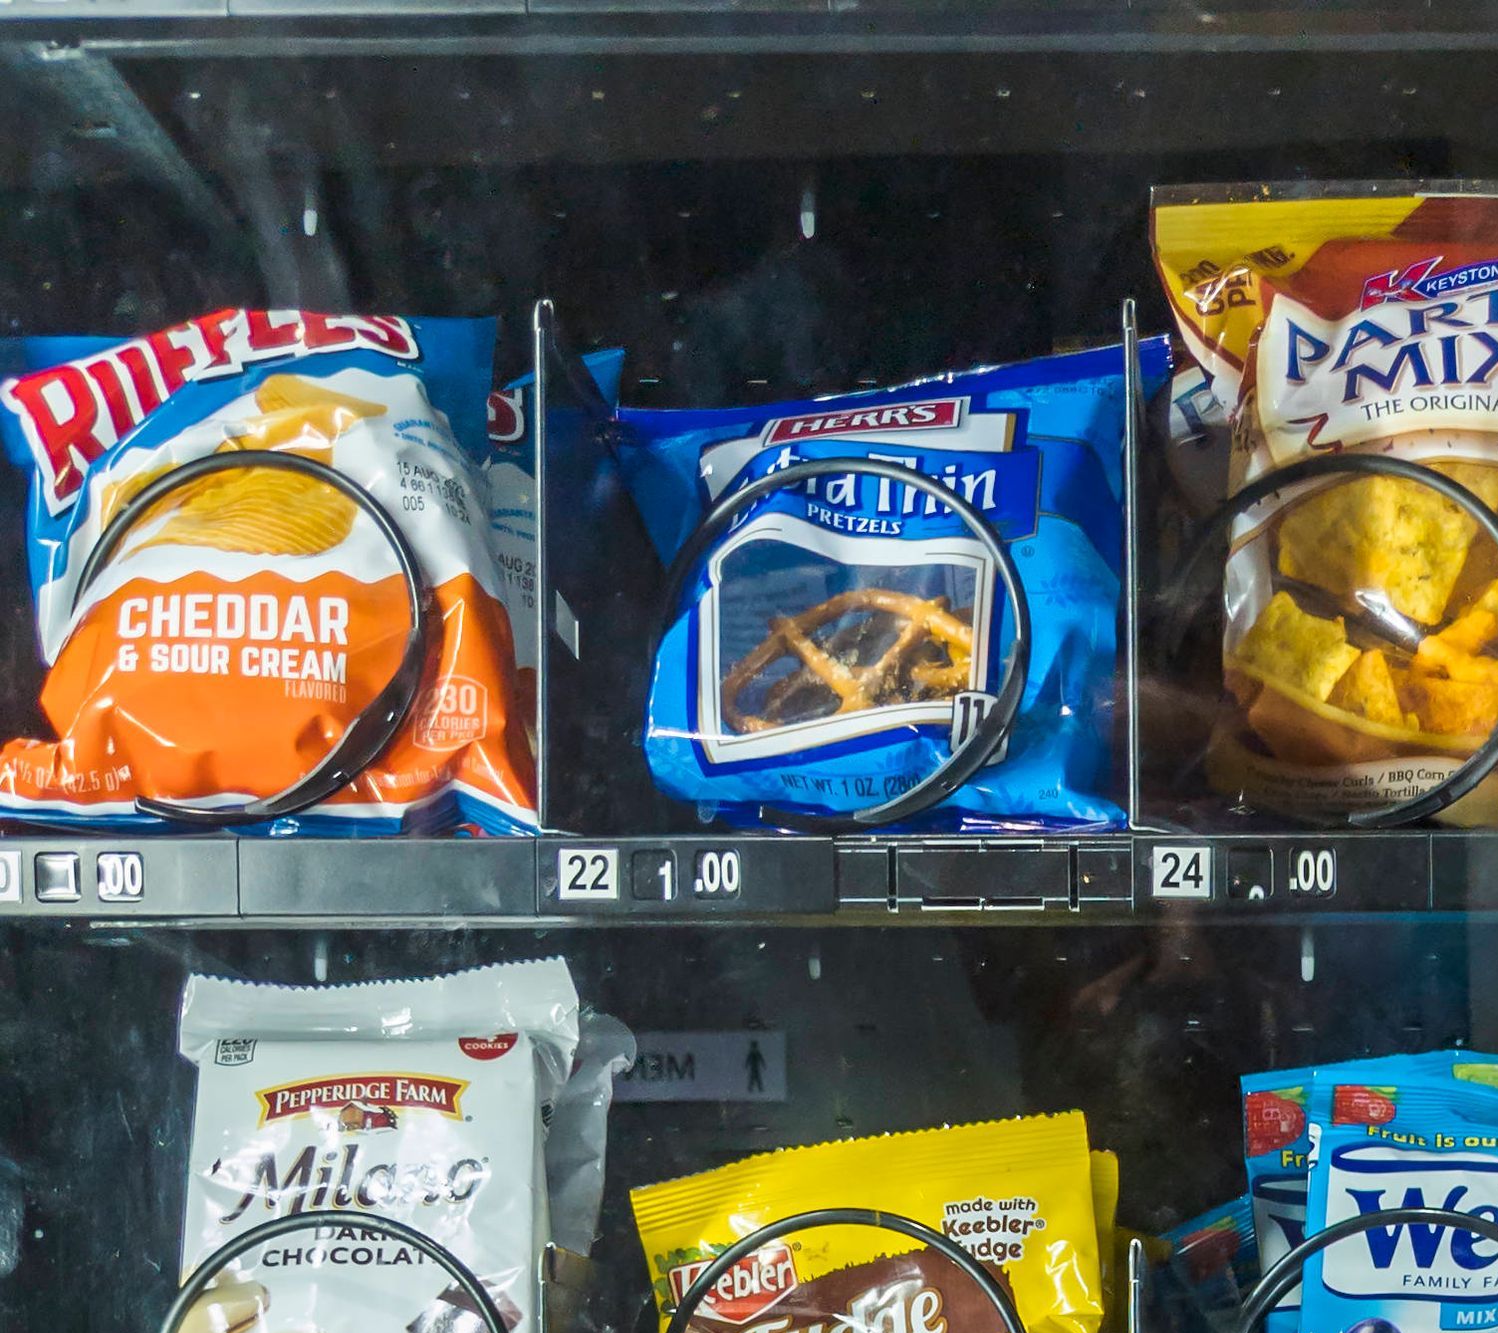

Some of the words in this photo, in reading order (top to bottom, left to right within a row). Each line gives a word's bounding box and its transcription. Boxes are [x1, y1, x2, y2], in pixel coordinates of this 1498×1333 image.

[791, 404, 937, 435] HERR'S
[1361, 402, 1403, 422] THE
[403, 496, 424, 511] 005
[807, 500, 902, 535] PRETZELS
[118, 593, 349, 646] CHEDDAR
[118, 647, 139, 672] &
[151, 644, 230, 676] SOUR
[241, 646, 347, 684] CREAM
[284, 680, 347, 704] FLAVORED
[781, 773, 810, 793] NET
[567, 855, 610, 891] 22
[1160, 853, 1203, 889] 24
[464, 1041, 509, 1051] COOKIES
[276, 1080, 390, 1114] PEPPERIDGE
[396, 1078, 447, 1106] FARM
[1368, 1126, 1427, 1147] Fruit
[1436, 1132, 1456, 1148] is
[945, 1199, 993, 1215] made
[999, 1197, 1036, 1212] with
[1403, 1273, 1473, 1290] FAMILY
